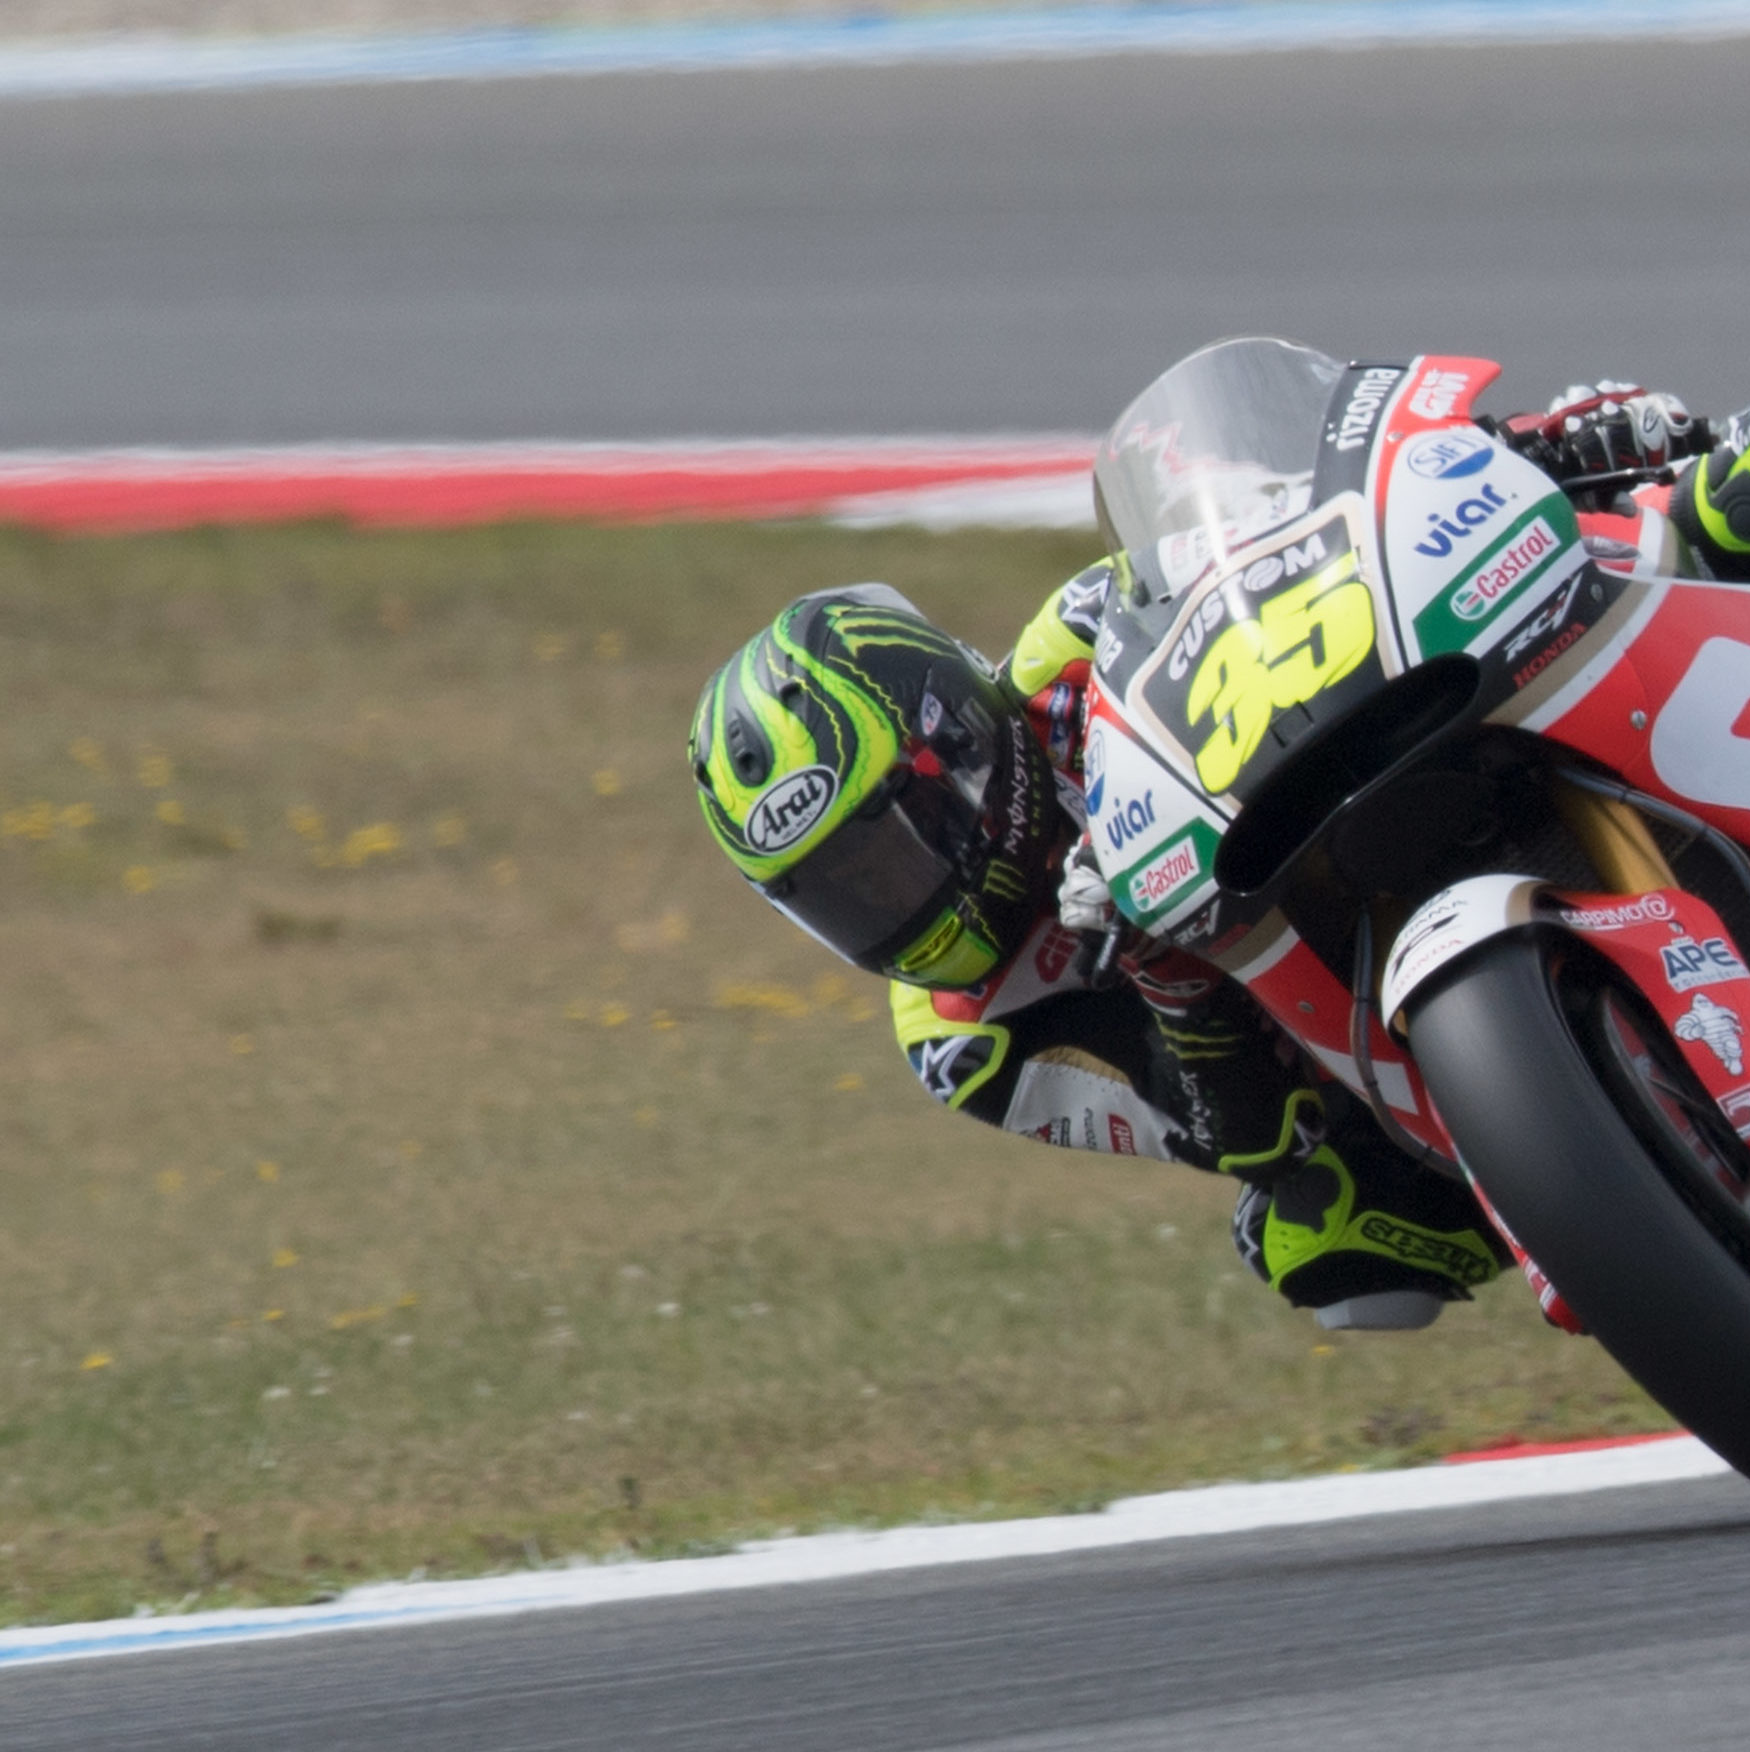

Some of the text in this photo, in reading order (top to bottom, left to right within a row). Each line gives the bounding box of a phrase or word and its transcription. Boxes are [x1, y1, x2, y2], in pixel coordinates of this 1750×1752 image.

[1326, 368, 1400, 451] rizoma
[1414, 483, 1507, 558] viar
[1476, 525, 1554, 600] Castrol
[1168, 533, 1327, 681] CUSTOM
[1187, 550, 1375, 793] 35
[1513, 622, 1588, 690] HONDA
[760, 773, 823, 851] Arai
[1106, 789, 1156, 850] viar
[1145, 845, 1196, 901] Castrol
[1662, 936, 1739, 980] APE
